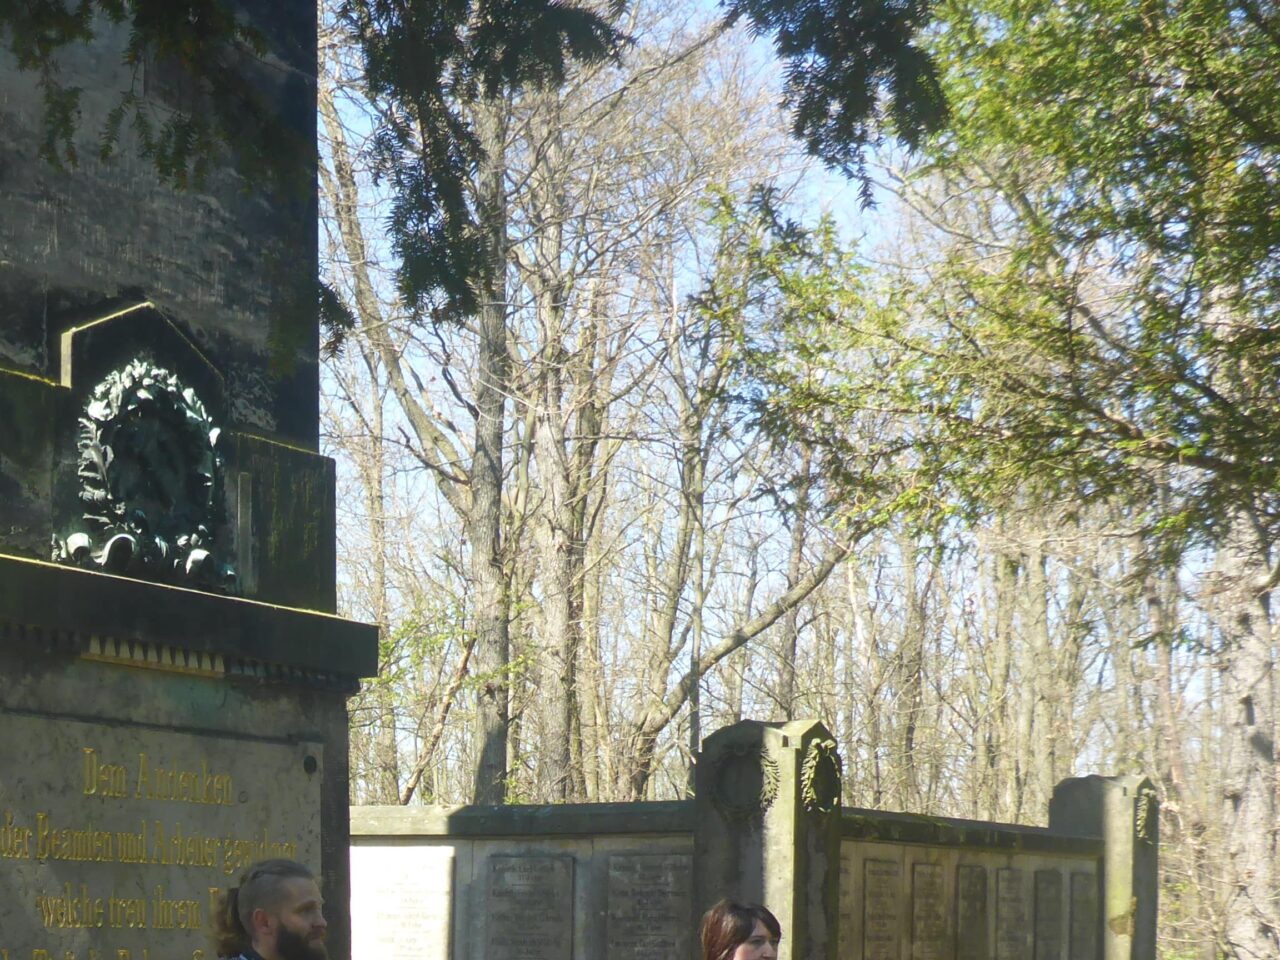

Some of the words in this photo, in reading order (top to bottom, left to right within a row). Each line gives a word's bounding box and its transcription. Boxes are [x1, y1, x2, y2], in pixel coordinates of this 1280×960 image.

[82, 747, 127, 798] Dem
[135, 752, 234, 806] Andenken
[0, 811, 33, 859] der
[36, 811, 113, 862] Beamten
[116, 819, 148, 864] und
[150, 820, 221, 867] Arbeiter
[36, 881, 104, 928] welche
[108, 888, 147, 928] treu
[151, 883, 202, 929] ihrem
